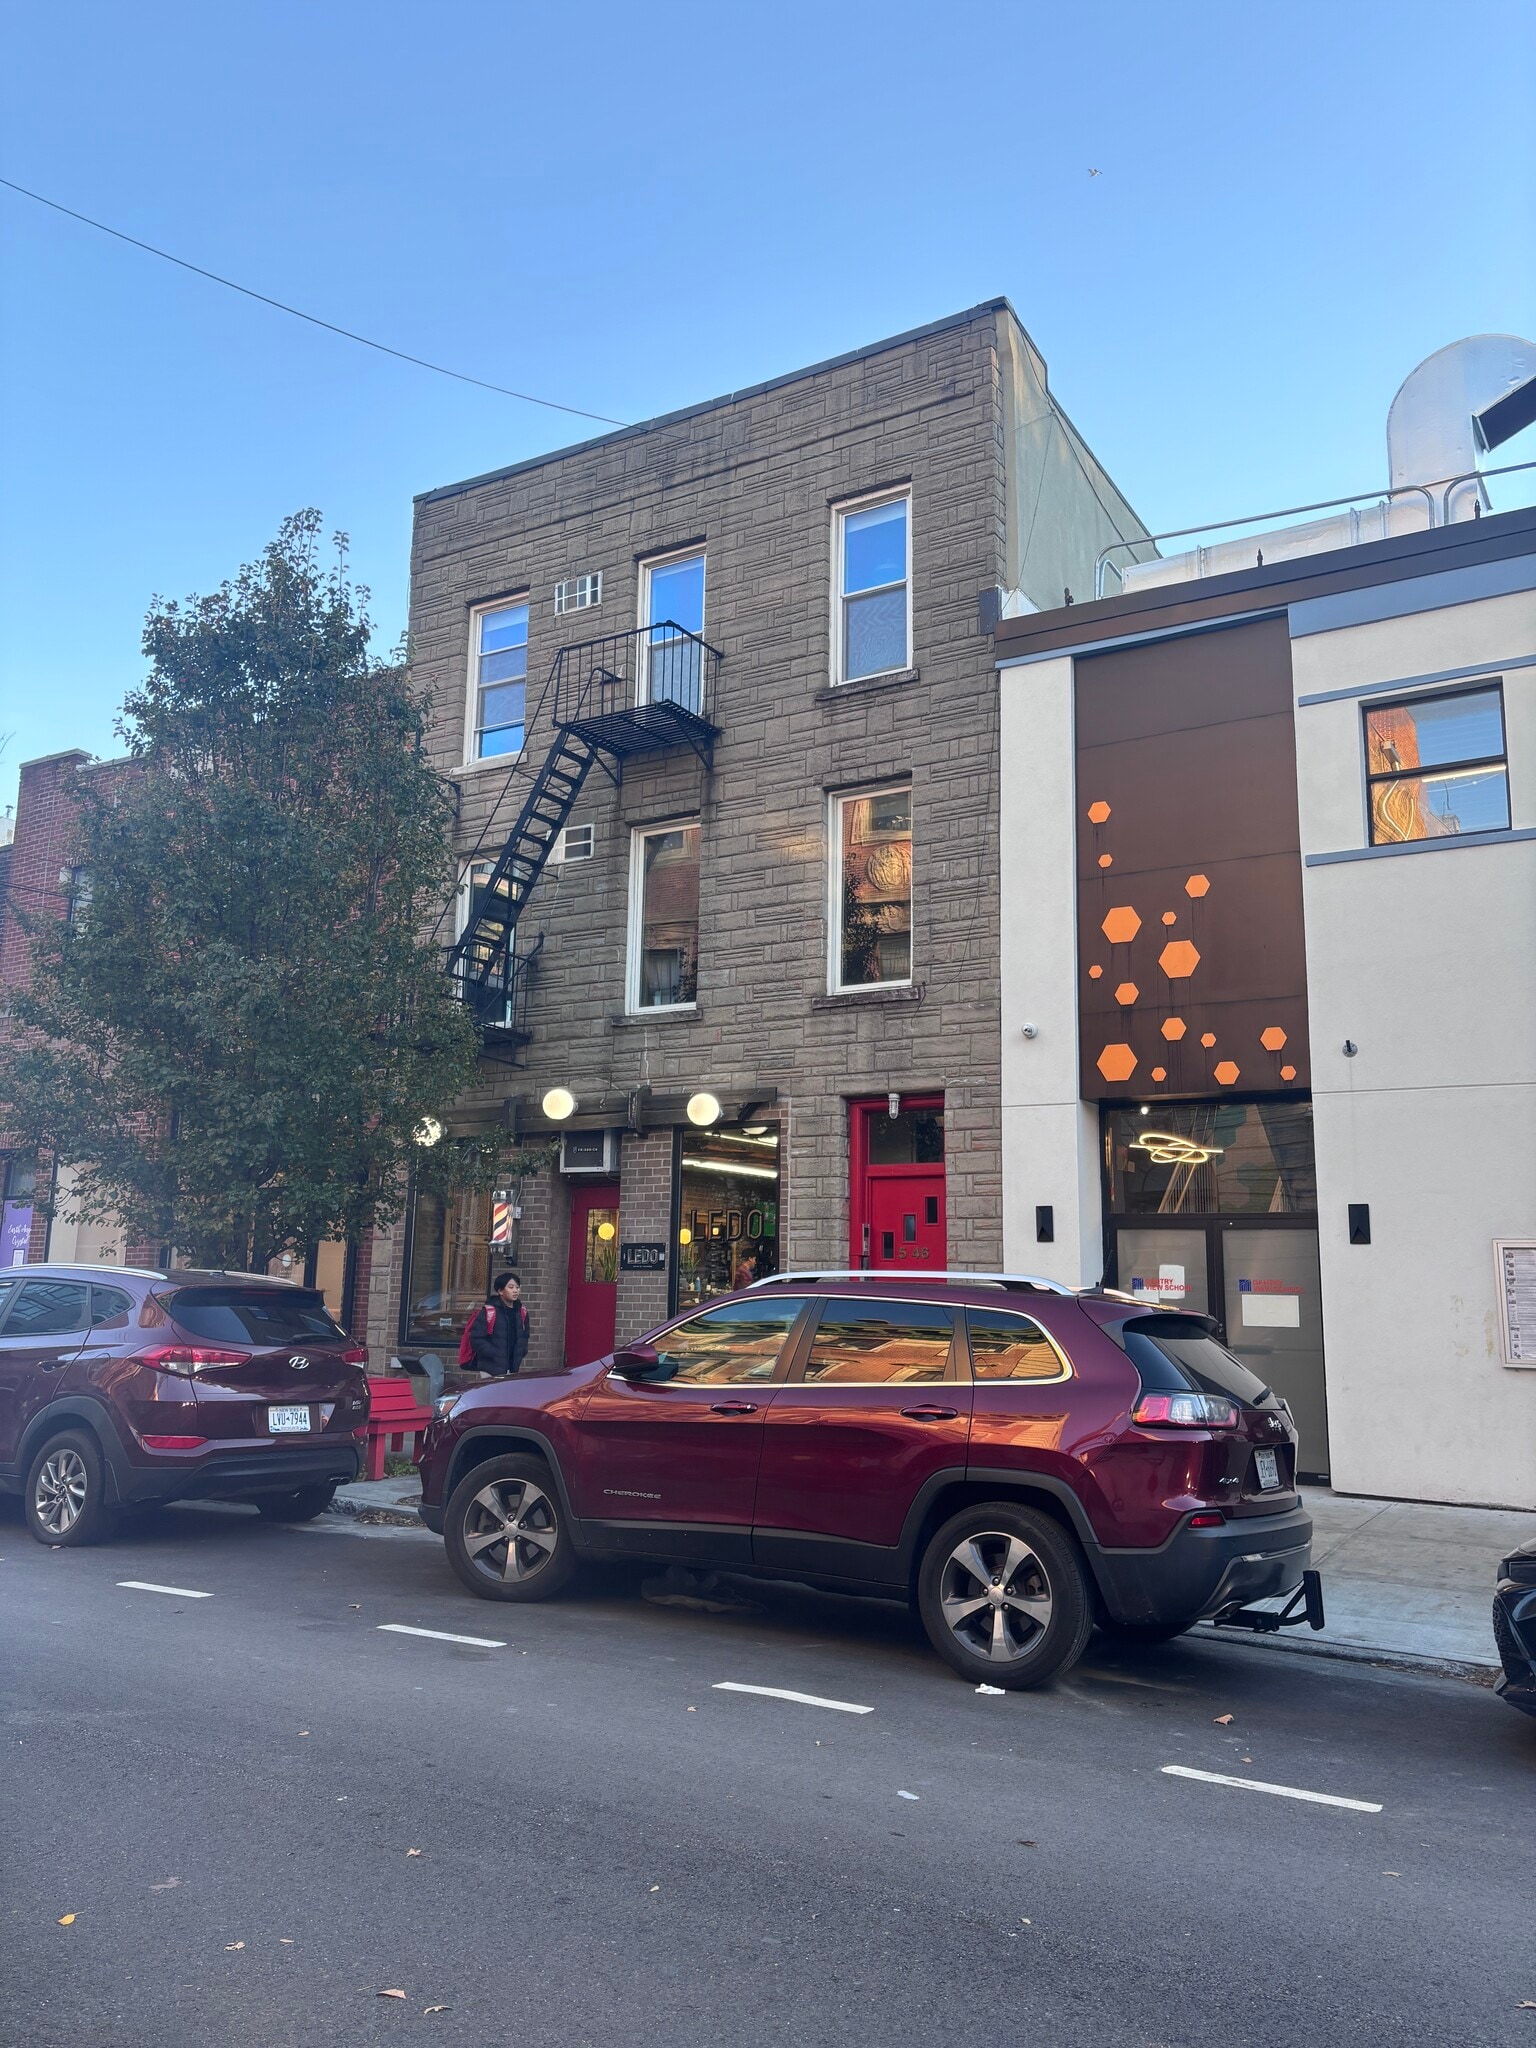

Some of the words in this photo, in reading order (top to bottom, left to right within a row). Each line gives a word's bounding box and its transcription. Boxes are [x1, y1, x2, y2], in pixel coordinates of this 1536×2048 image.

[691, 1209, 762, 1241] LEDO
[627, 1248, 658, 1265] LEDO
[603, 1489, 662, 1500] CHEROKEE
